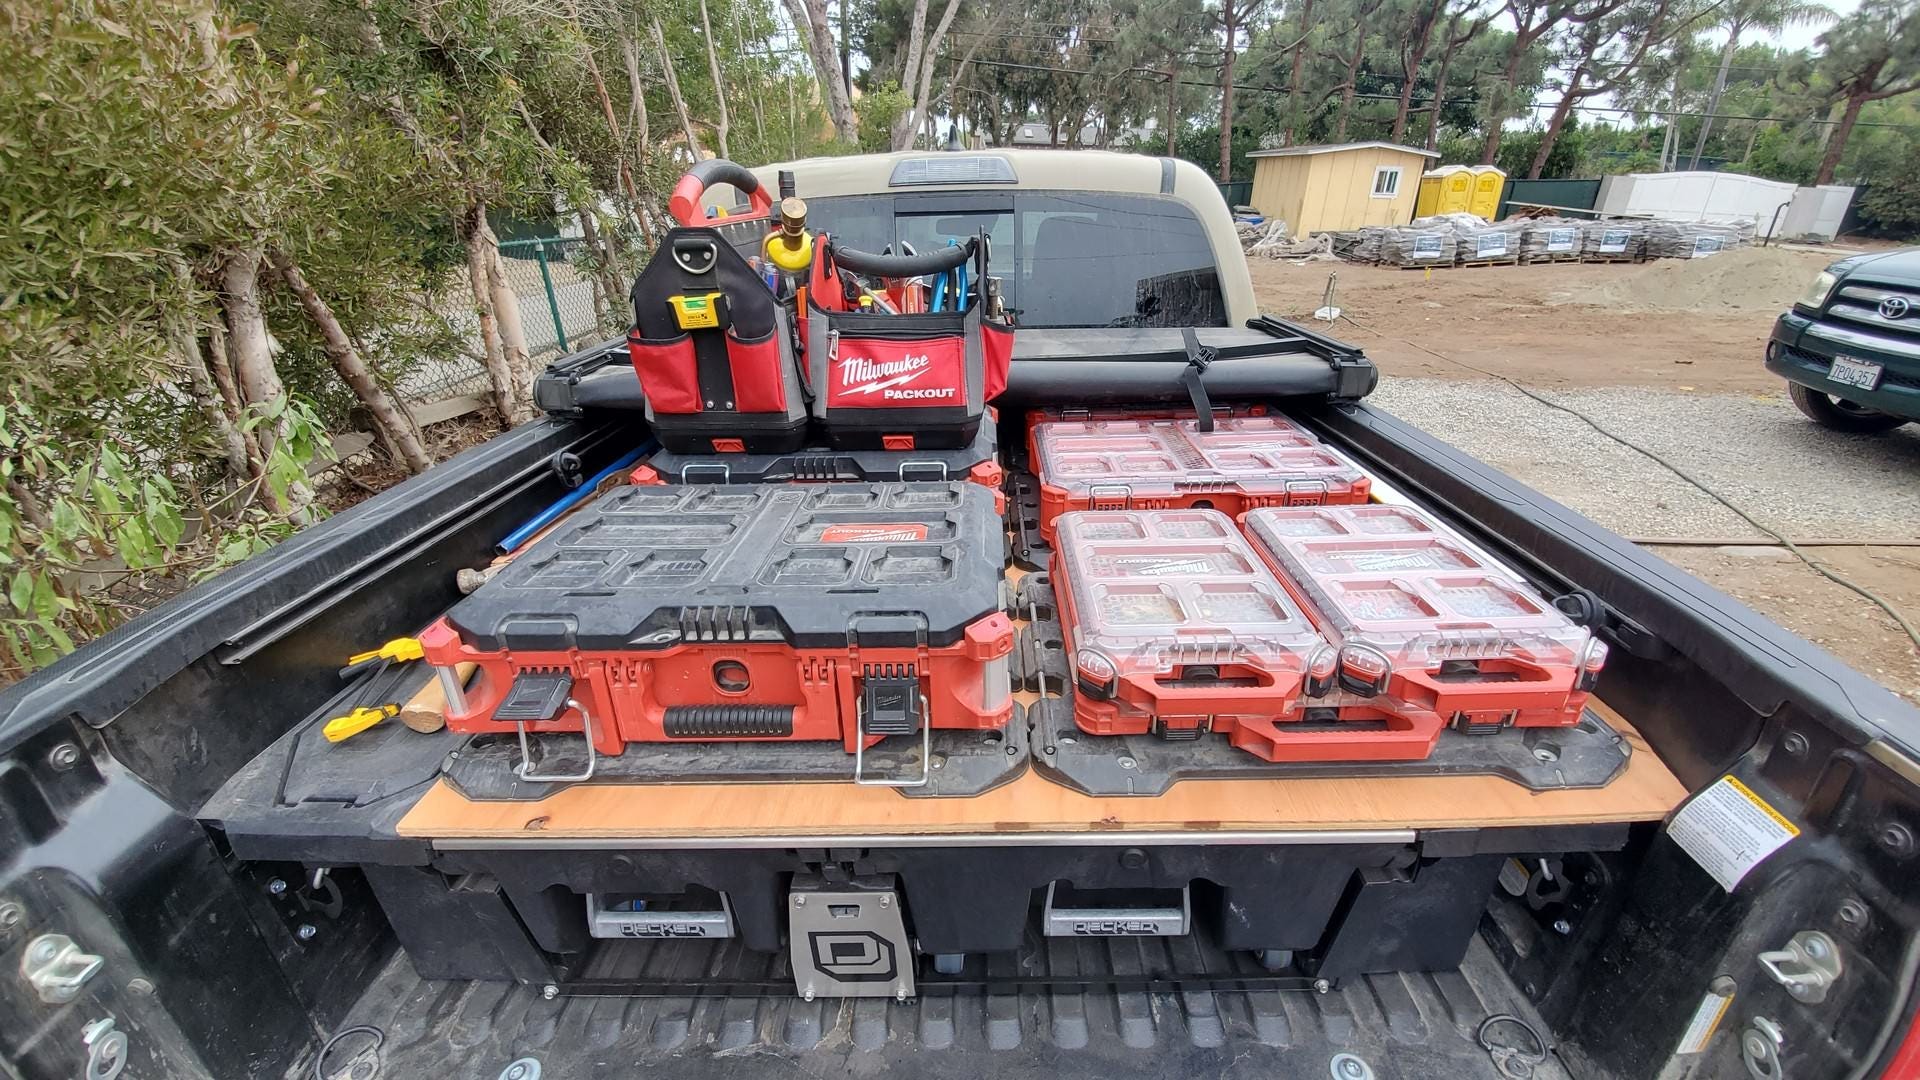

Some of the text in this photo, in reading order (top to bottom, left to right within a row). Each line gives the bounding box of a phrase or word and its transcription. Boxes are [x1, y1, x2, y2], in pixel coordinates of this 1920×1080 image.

[838, 354, 930, 386] Milwaukee
[884, 388, 955, 399] PACKOUT
[620, 922, 706, 936] DECKED
[1073, 920, 1160, 935] DECKED
